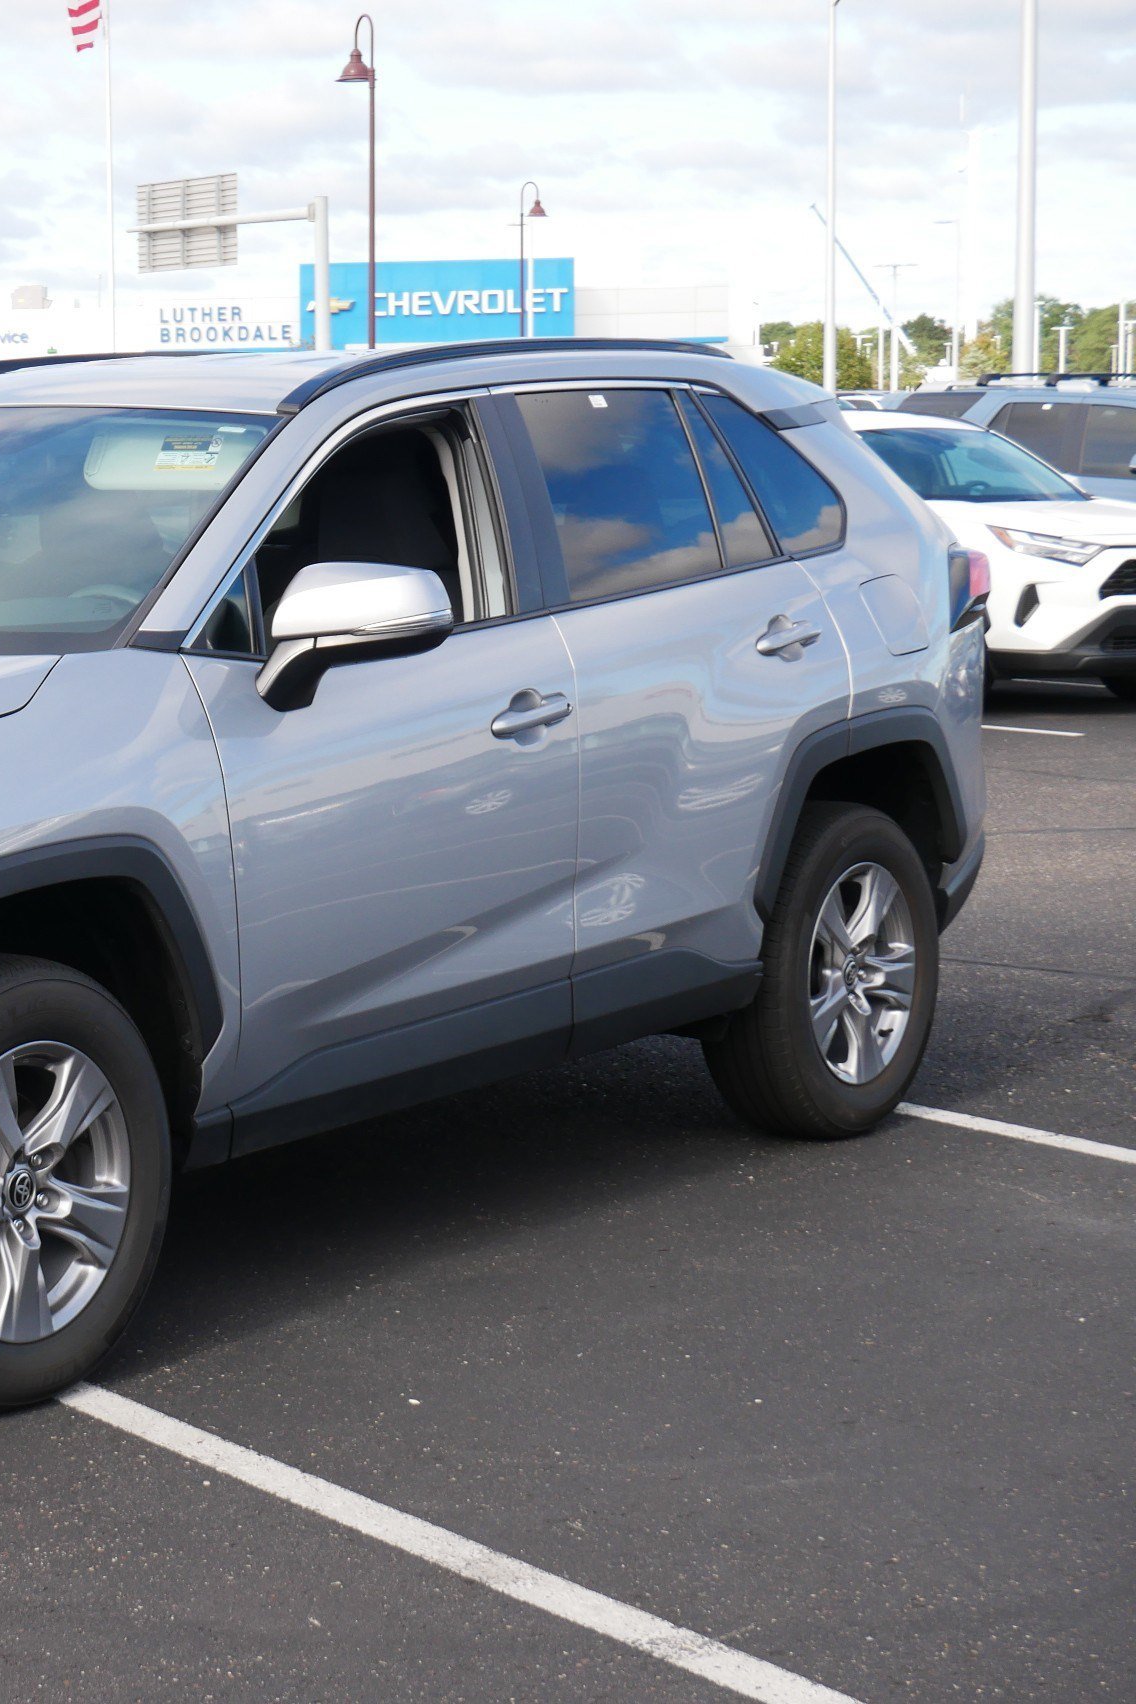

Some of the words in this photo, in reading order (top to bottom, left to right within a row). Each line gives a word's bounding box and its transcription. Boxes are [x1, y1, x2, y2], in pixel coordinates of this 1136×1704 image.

[373, 287, 569, 316] CHEVROLET
[160, 306, 243, 324] LUTHER
[160, 324, 292, 343] BROOKDALE
